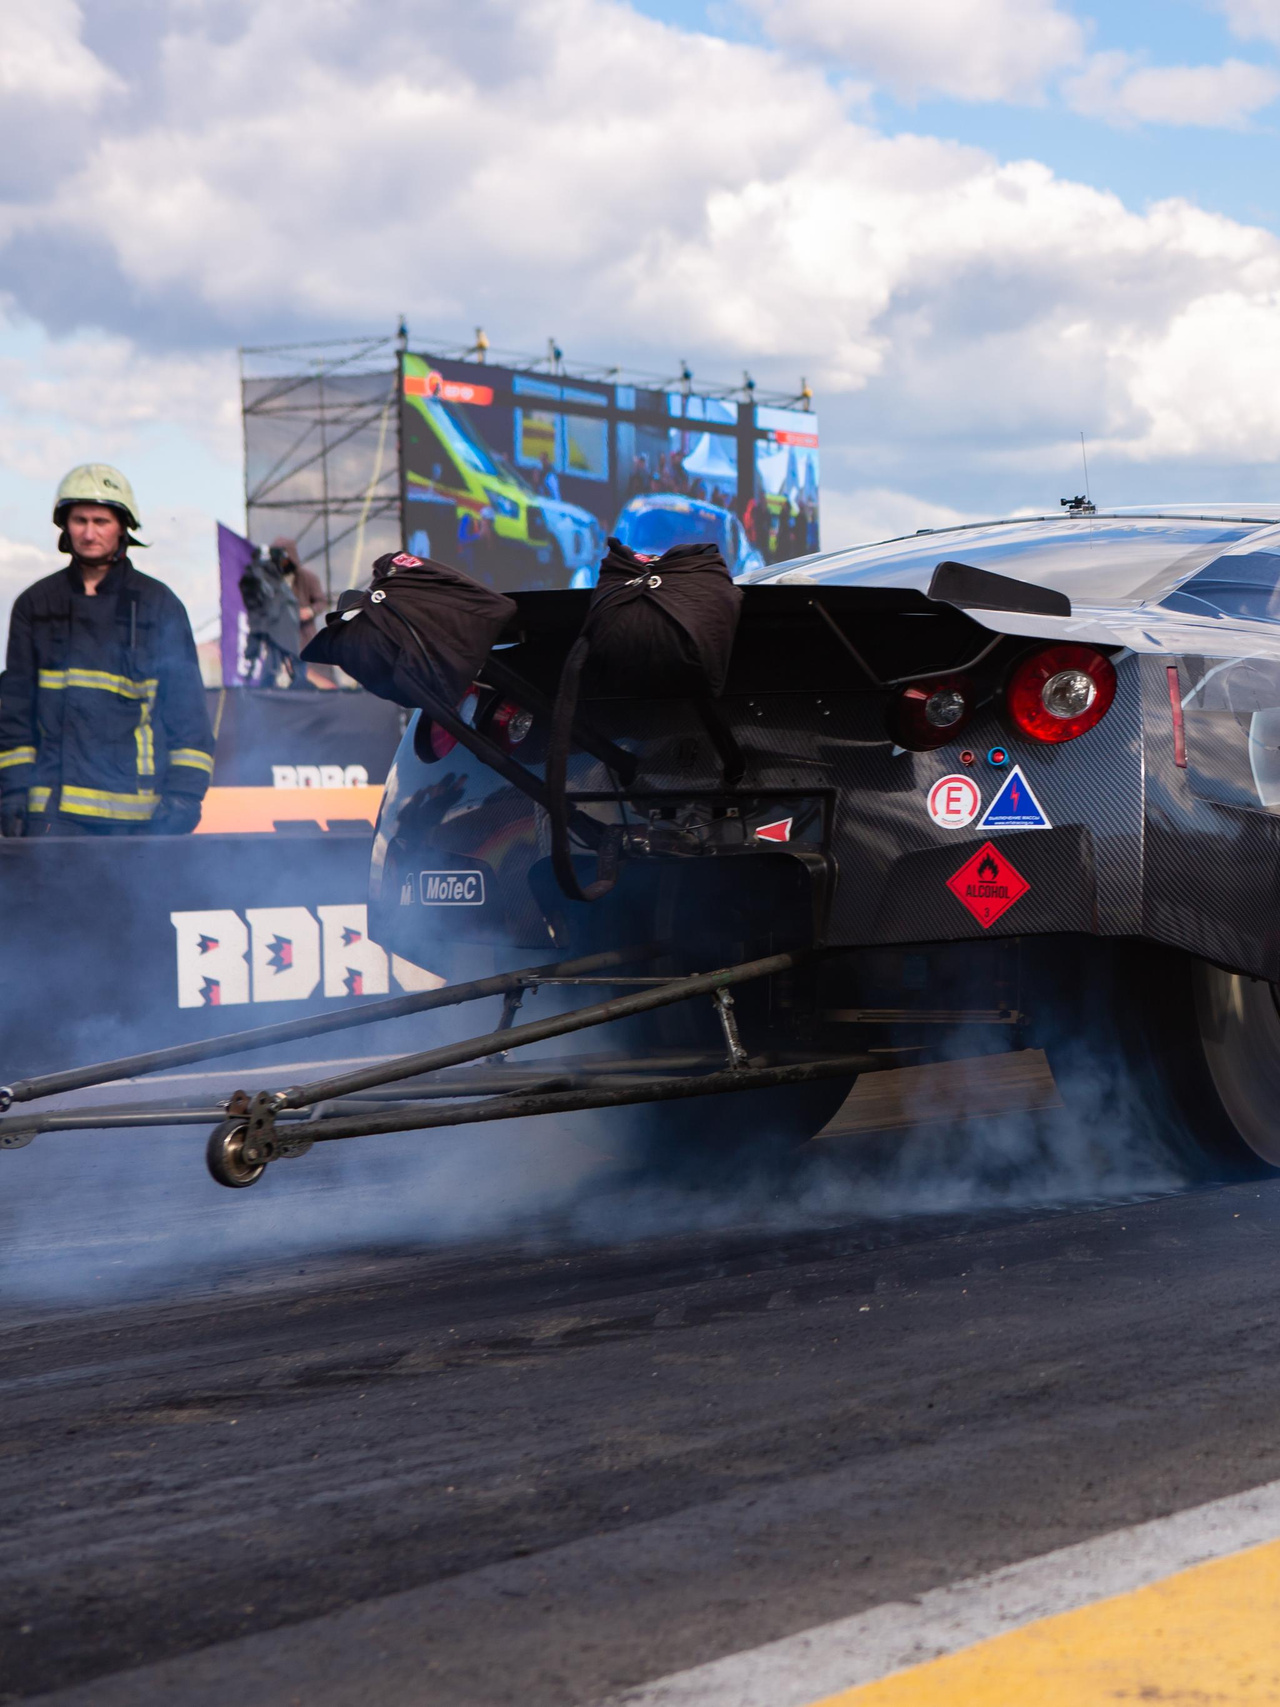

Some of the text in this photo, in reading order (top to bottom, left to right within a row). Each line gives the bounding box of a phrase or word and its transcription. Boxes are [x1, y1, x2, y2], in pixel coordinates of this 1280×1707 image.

[945, 786, 963, 814] E
[426, 876, 477, 900] MoTeC
[965, 884, 1010, 899] ALCOHOL
[984, 907, 990, 918] 3
